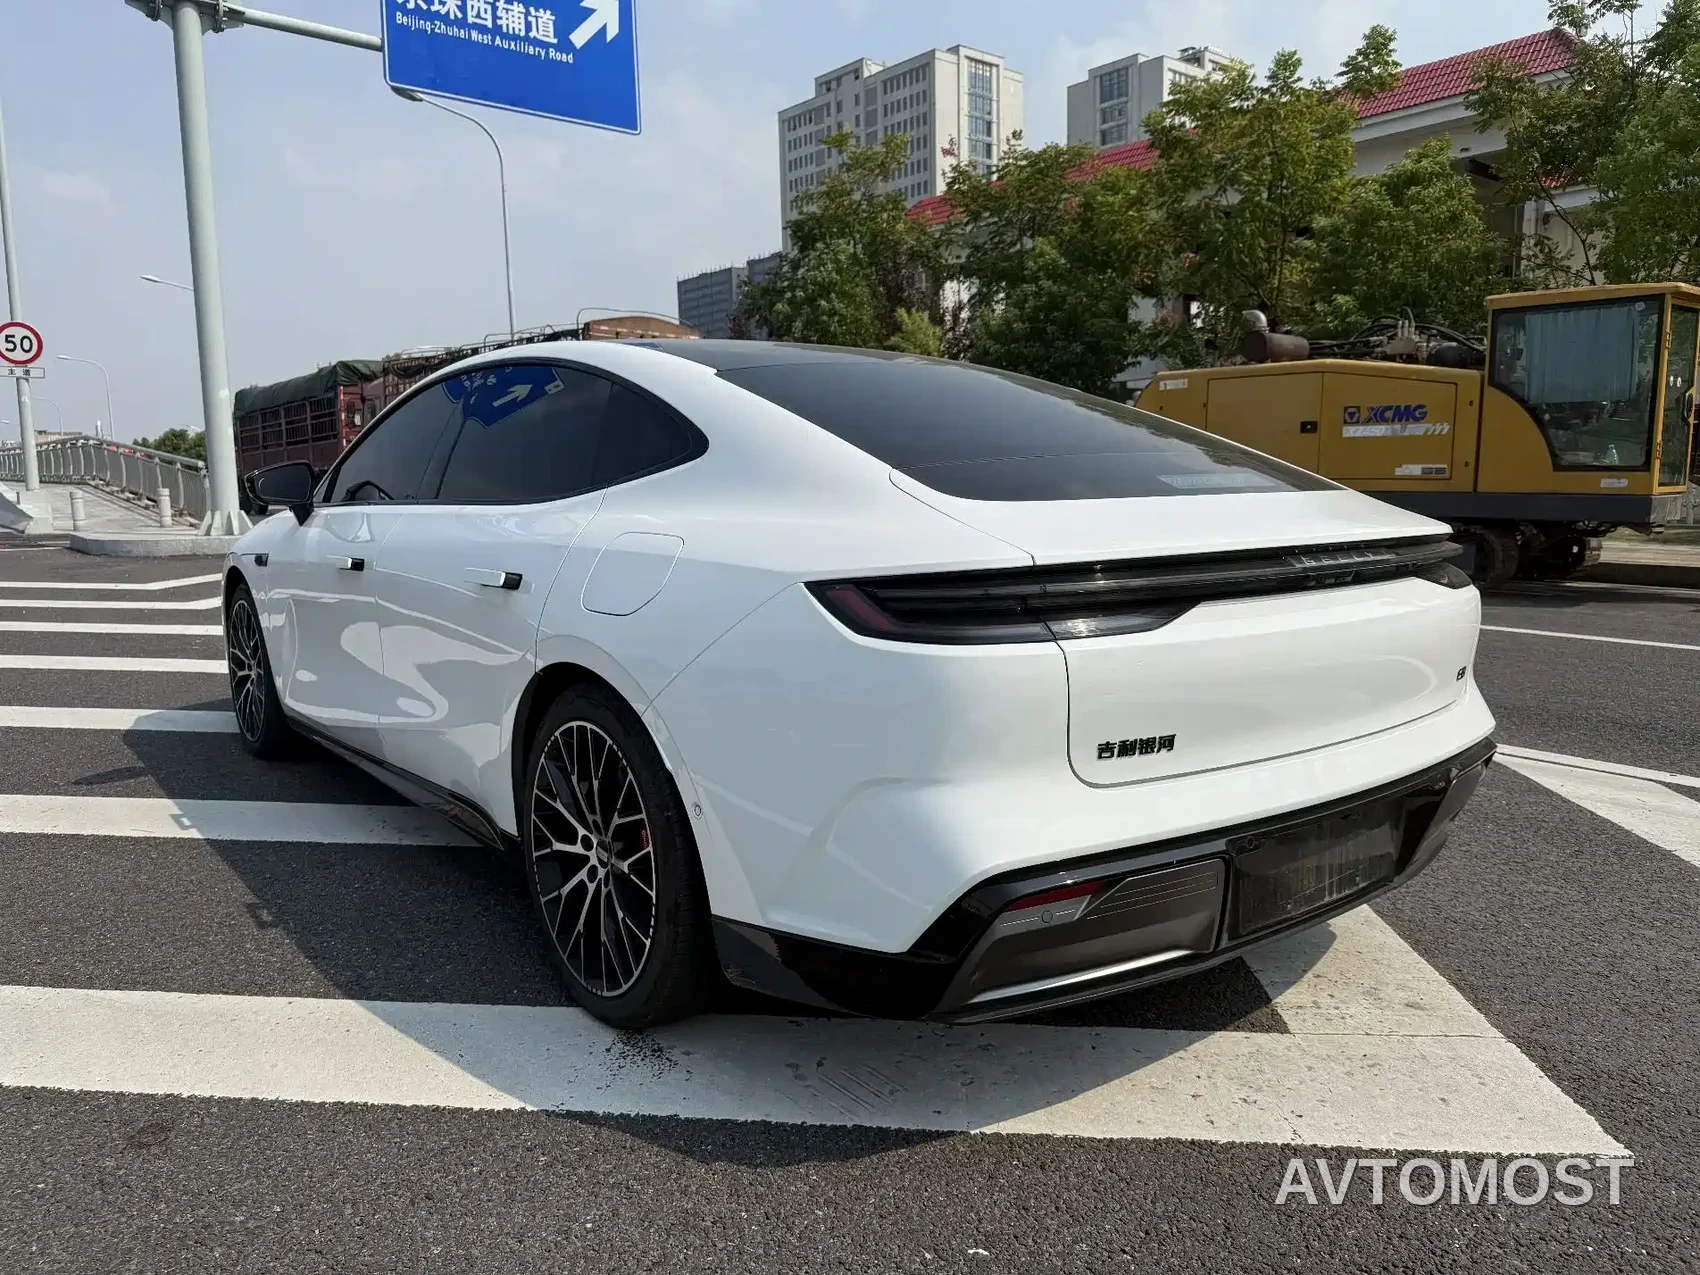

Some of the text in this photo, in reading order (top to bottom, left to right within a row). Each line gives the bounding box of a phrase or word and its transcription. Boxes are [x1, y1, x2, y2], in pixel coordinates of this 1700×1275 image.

[396, 11, 573, 64] Beijing-Zhuhai West Auxiliary Road
[5, 334, 33, 353] 50
[1364, 403, 1428, 424] XCMG
[1097, 733, 1176, 760] 吉利银河
